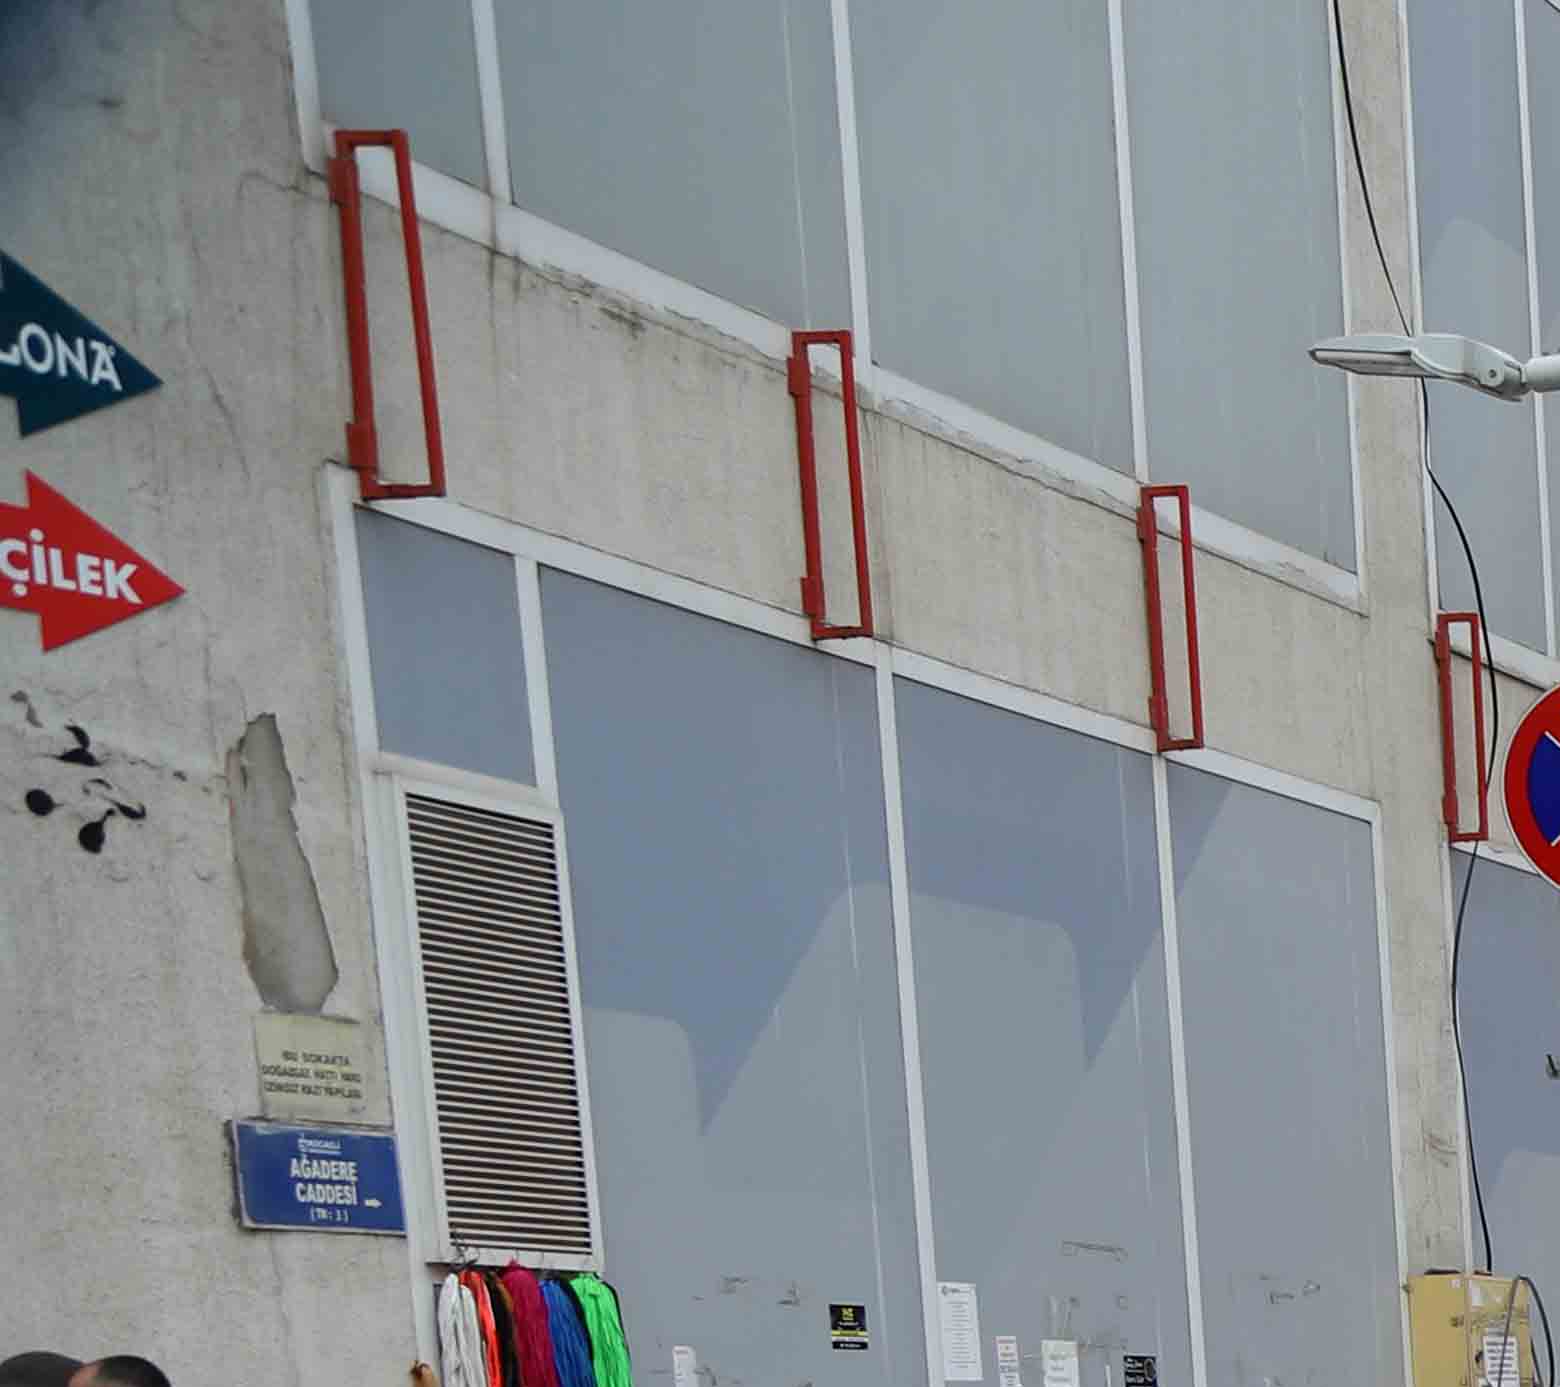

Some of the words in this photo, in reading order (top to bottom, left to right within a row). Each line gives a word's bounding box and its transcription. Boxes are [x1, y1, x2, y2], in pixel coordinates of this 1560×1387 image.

[0, 528, 143, 604] ÇİLEK
[290, 1153, 358, 1181] AĞADERE
[295, 1182, 358, 1206] CADDESİ
